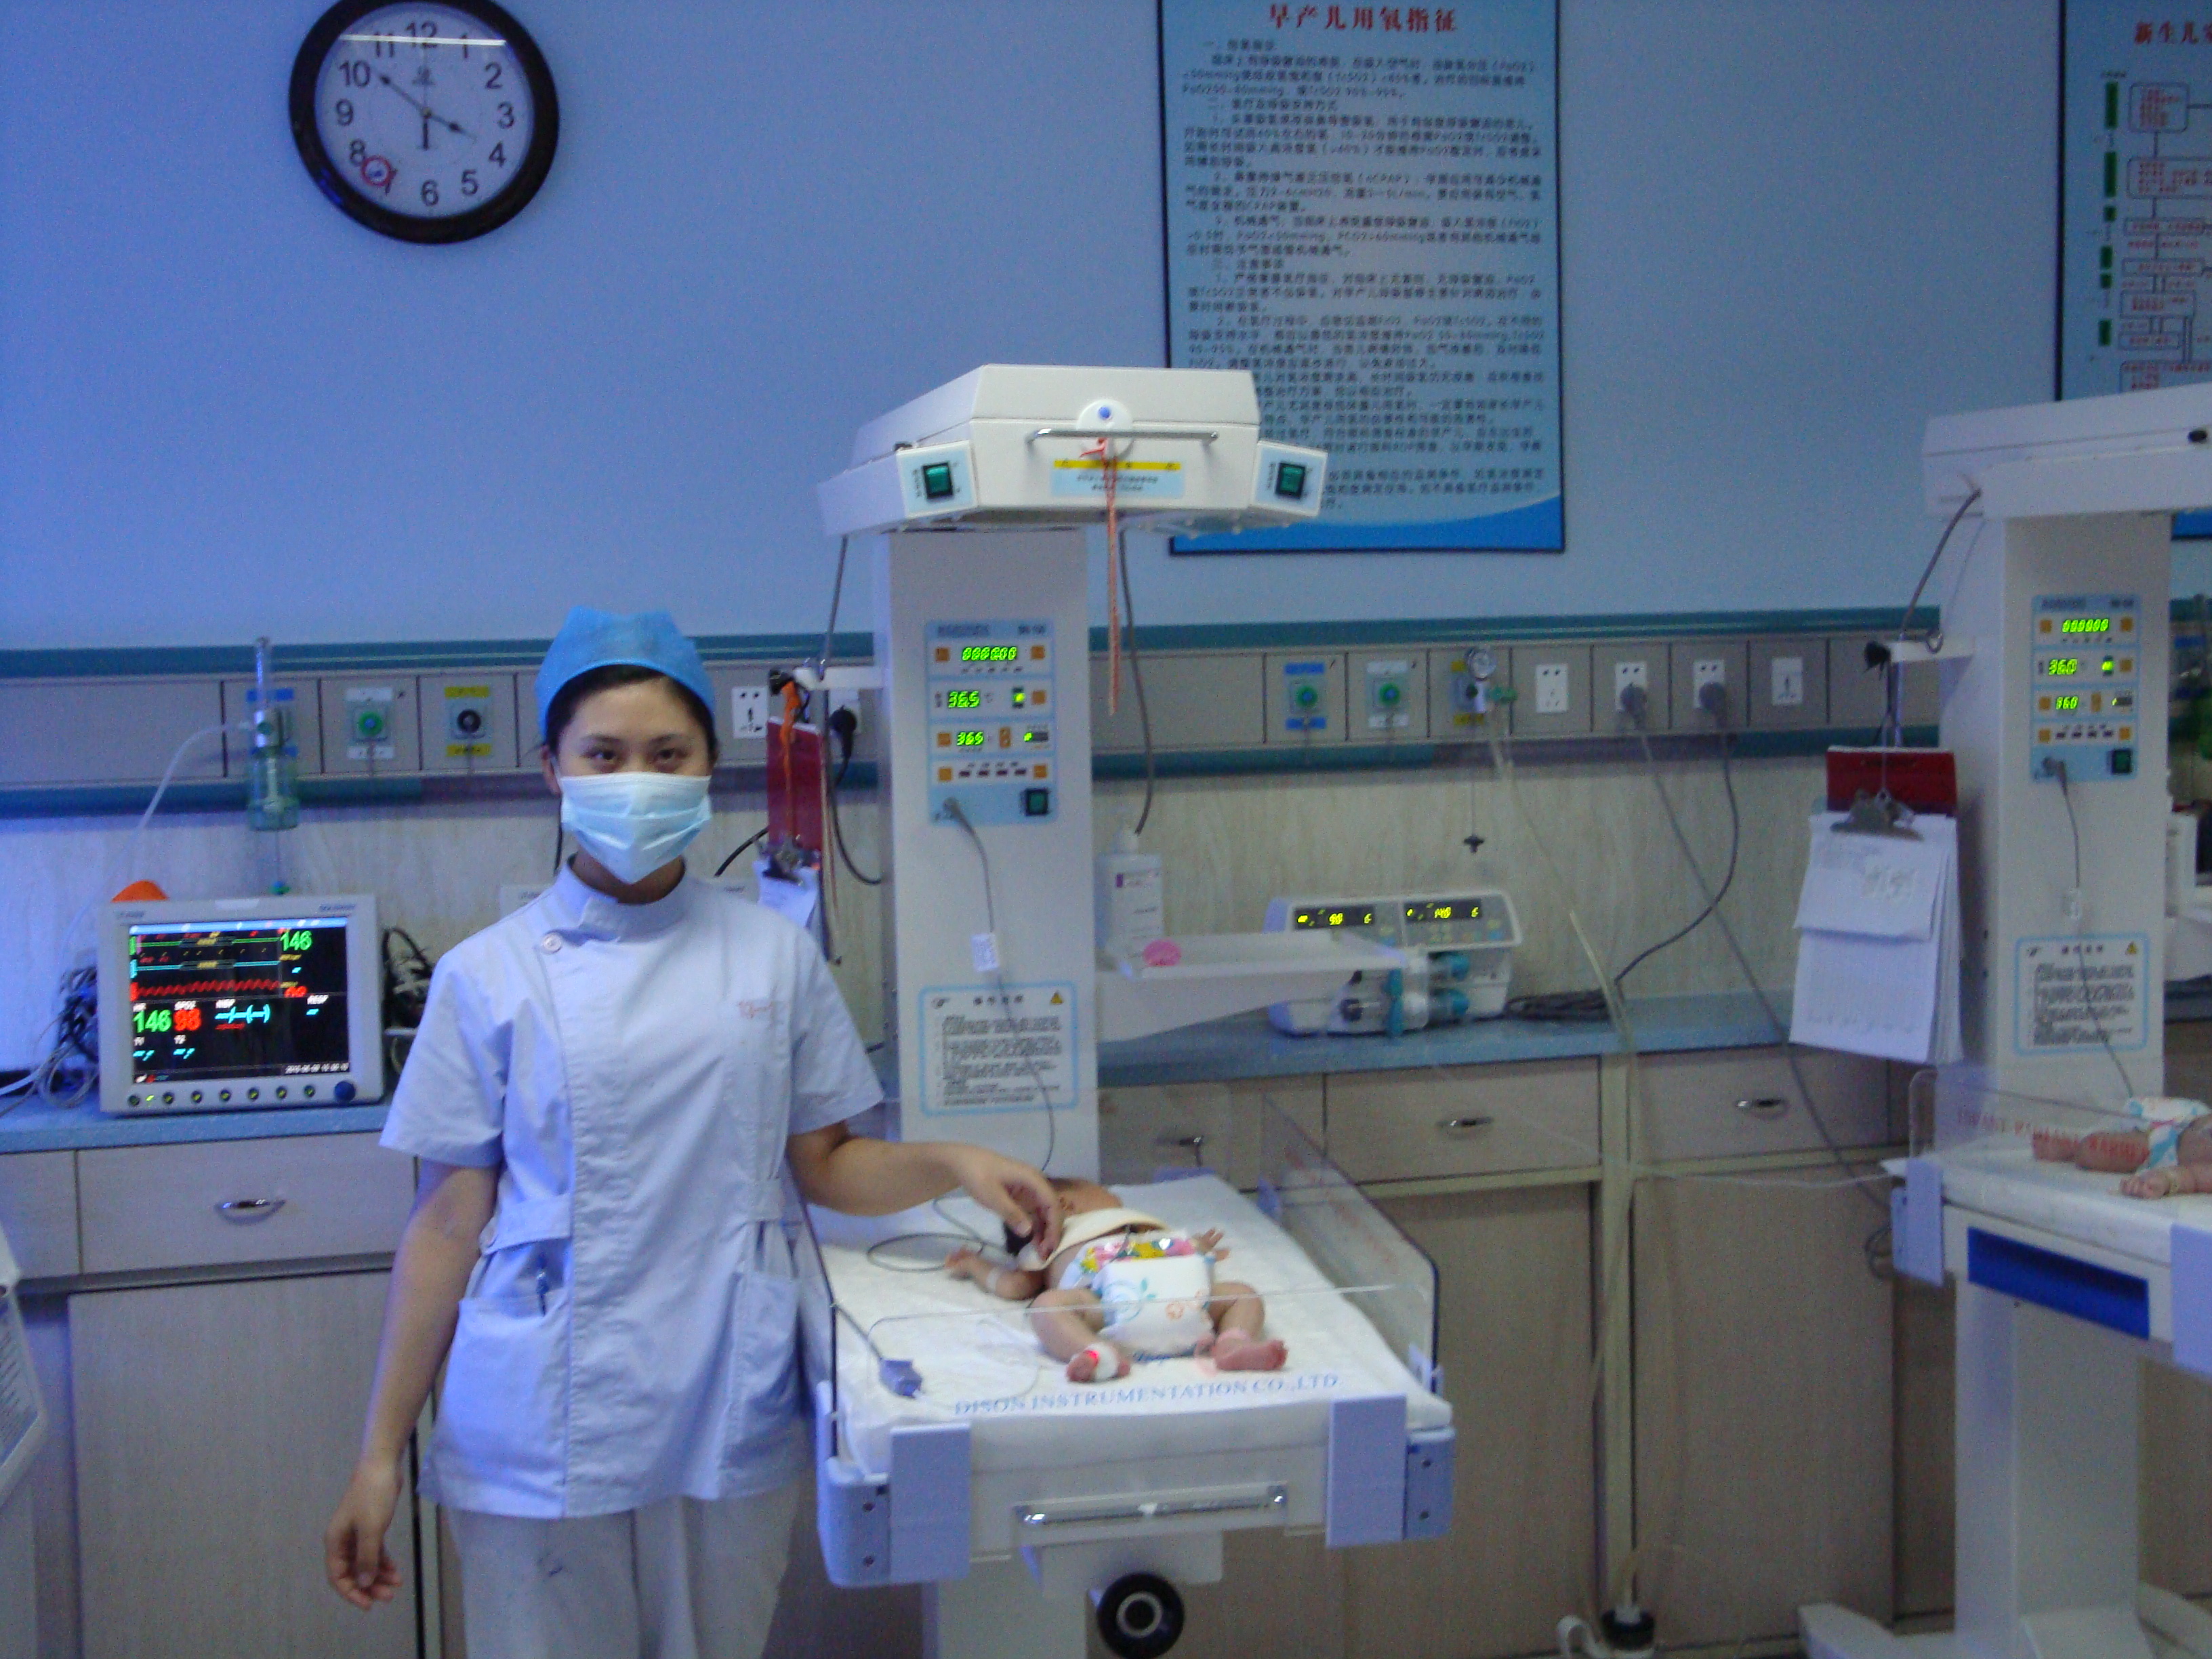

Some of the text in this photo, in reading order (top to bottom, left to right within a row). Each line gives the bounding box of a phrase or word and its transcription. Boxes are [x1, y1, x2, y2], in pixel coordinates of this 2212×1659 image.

[373, 32, 396, 58] 11
[406, 21, 438, 50] 12
[339, 60, 371, 87] 10
[485, 62, 503, 89] 2
[335, 98, 354, 127] 9
[497, 101, 515, 129] 3
[348, 139, 367, 167] 8
[488, 141, 507, 168] 4
[421, 179, 440, 206] 6
[461, 169, 479, 197] 5
[279, 930, 312, 951] 146
[132, 1009, 173, 1033] 146
